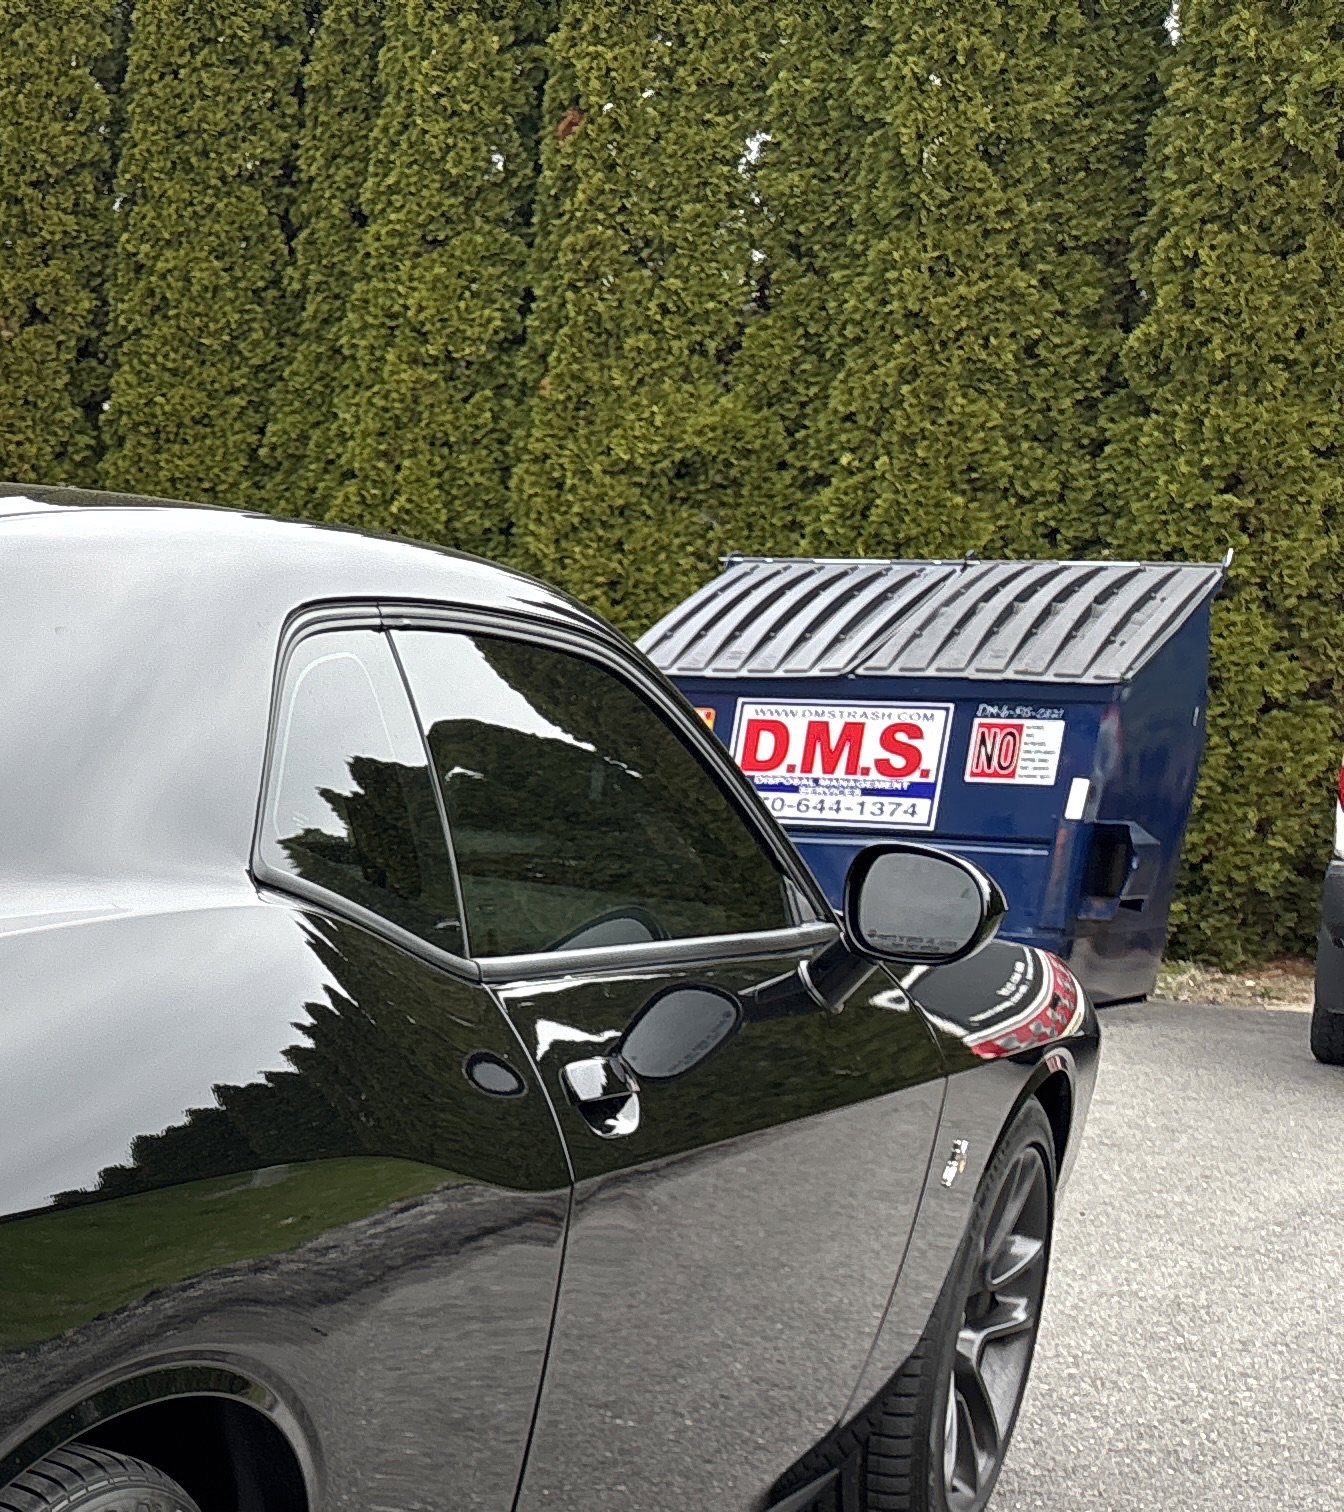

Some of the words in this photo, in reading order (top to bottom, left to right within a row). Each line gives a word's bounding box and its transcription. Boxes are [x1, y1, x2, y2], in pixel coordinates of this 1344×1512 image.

[741, 719, 930, 778] D.M.S.
[973, 727, 1020, 774] NO
[762, 796, 918, 817] 0-644-1374
